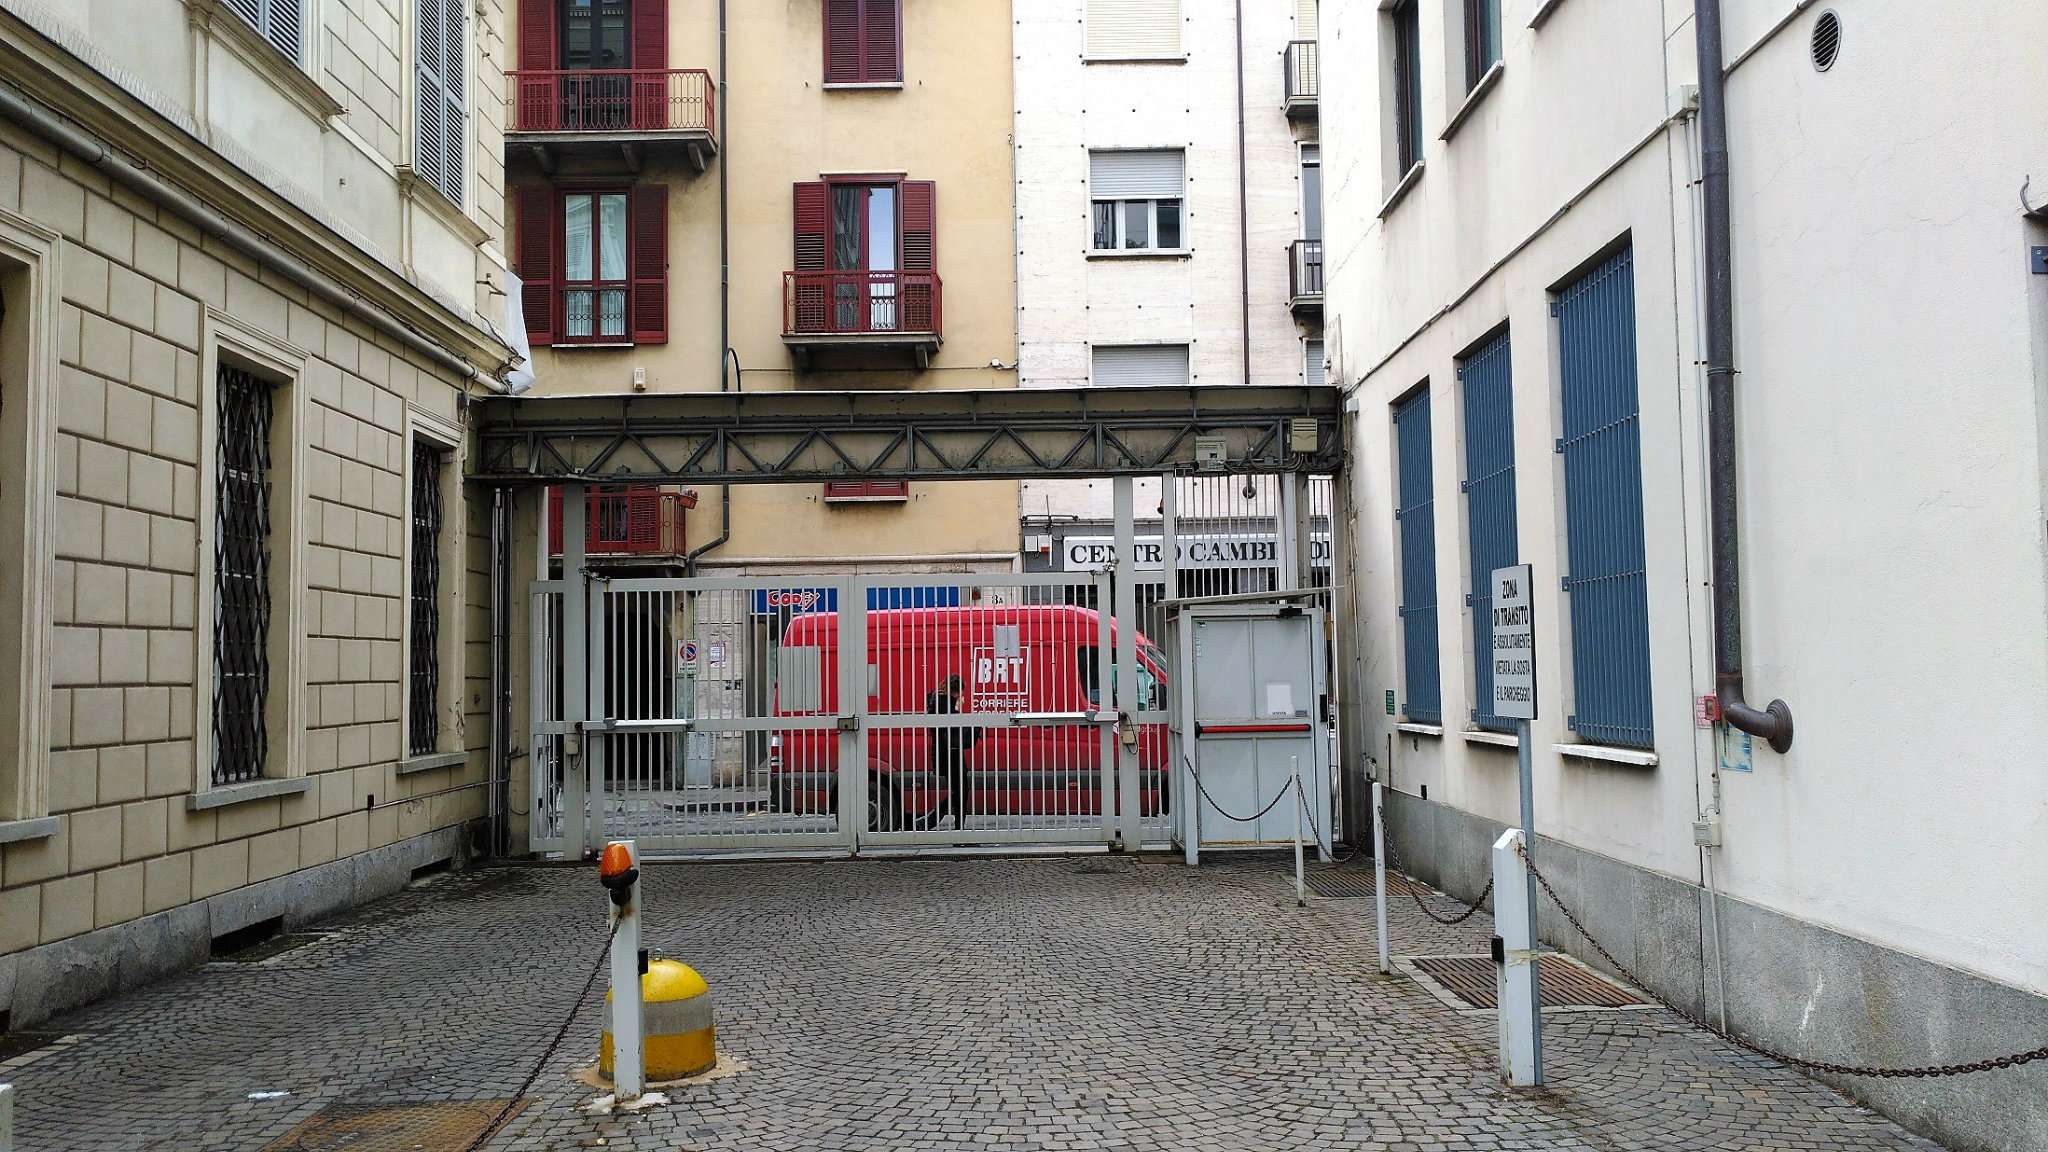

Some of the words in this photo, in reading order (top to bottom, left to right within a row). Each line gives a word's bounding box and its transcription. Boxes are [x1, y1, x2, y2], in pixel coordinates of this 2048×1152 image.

[1070, 544, 1181, 563] CETR
[1502, 579, 1517, 599] ZONA
[1493, 608, 1499, 627] DI
[1501, 605, 1528, 626] TRANSITO
[978, 658, 1023, 683] BRT
[1495, 660, 1510, 674] VIETATA
[1504, 685, 1530, 701] PARCHEGGIO
[972, 699, 1028, 708] CORRIERE
